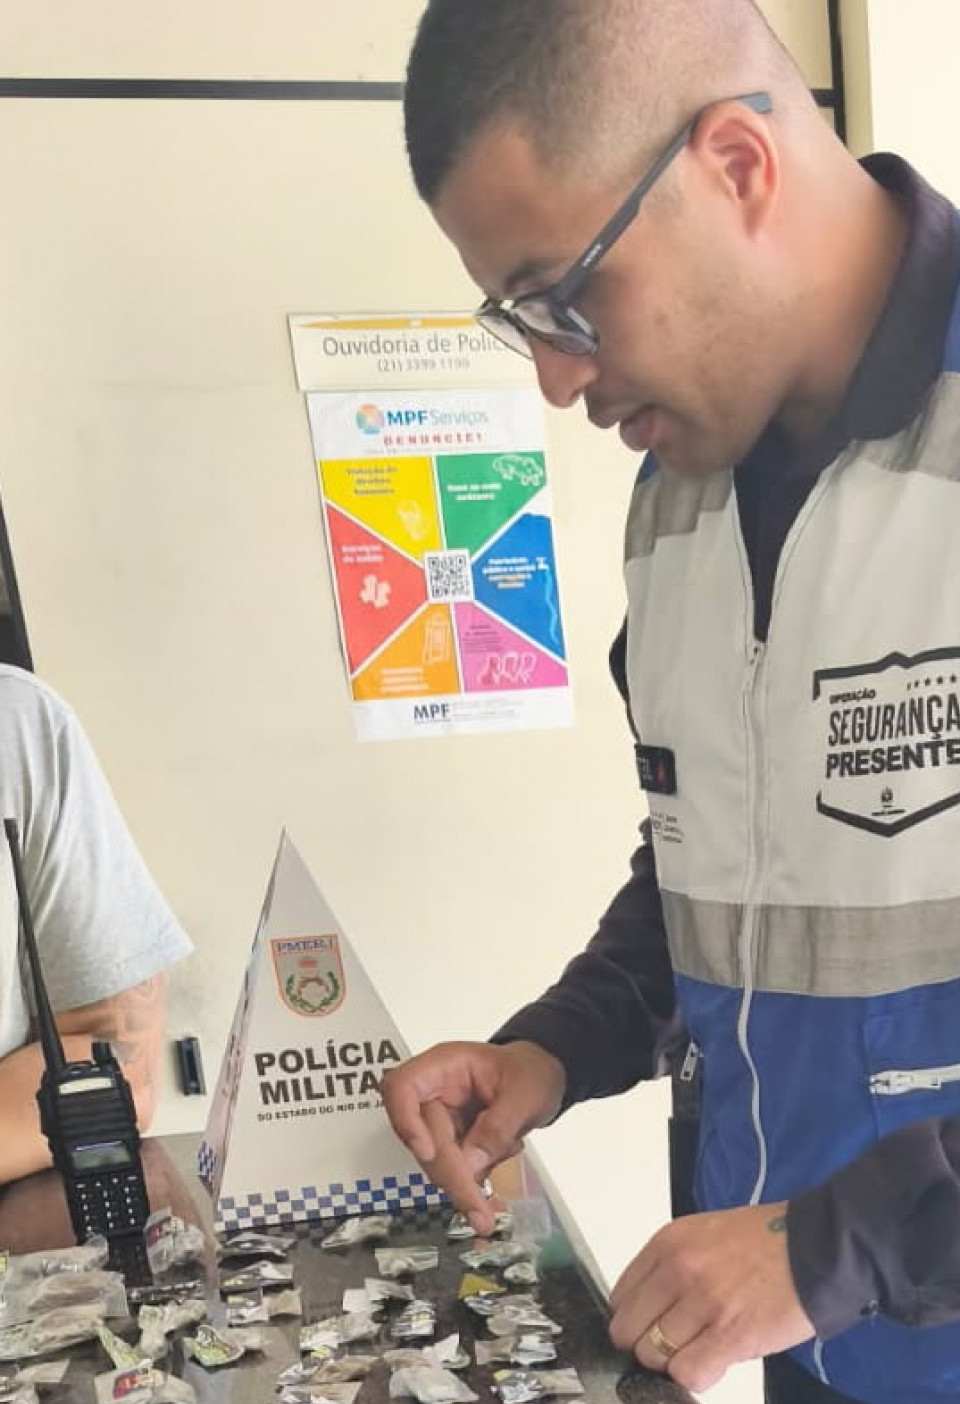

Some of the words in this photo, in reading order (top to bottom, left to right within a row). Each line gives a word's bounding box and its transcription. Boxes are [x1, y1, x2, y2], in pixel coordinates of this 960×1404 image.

[323, 334, 418, 356] Ouvidoria
[427, 333, 450, 352] de
[414, 703, 449, 719] MPF
[255, 1039, 400, 1076] POLÍCIA
[260, 1069, 394, 1105] MILITA
